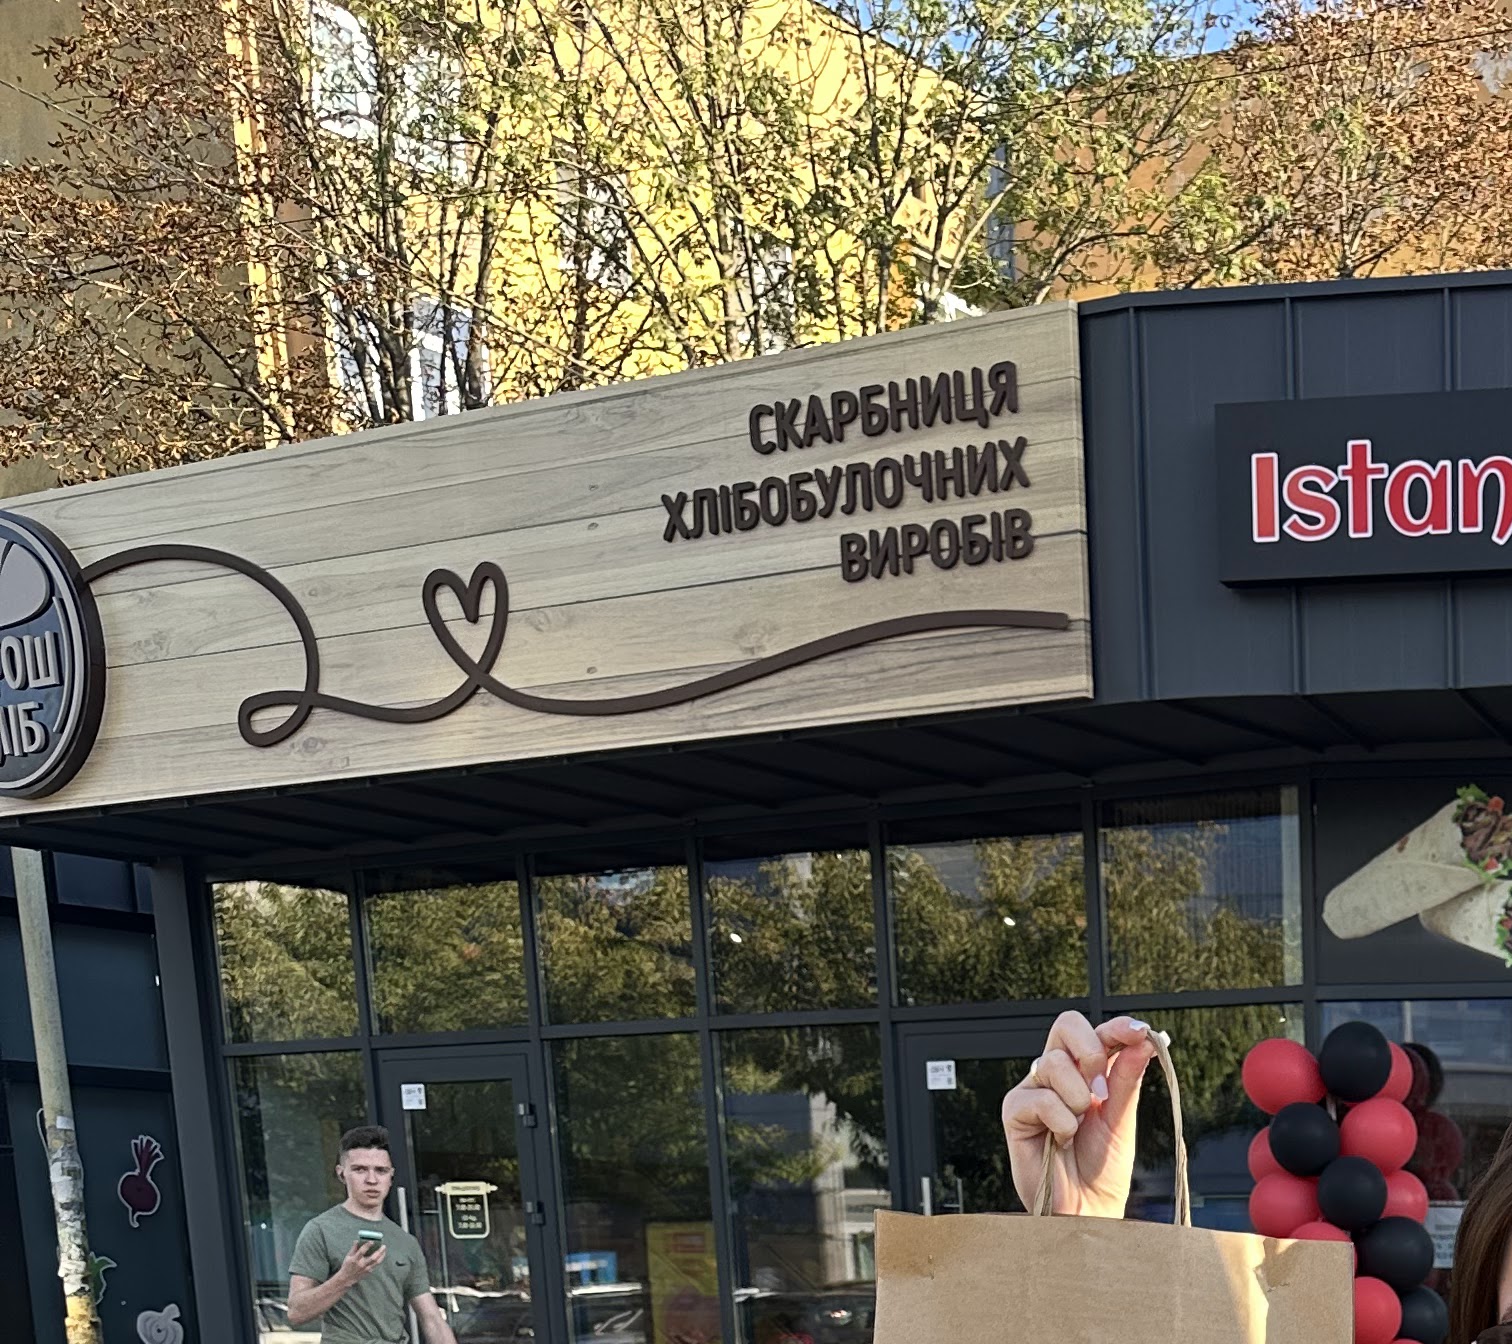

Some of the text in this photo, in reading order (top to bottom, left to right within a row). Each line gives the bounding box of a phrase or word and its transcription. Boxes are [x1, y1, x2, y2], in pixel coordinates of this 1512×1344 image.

[748, 360, 1019, 455] СКАРБНИЦЯ
[661, 436, 1031, 542] ХЛІБОБУЛОЧНИХ
[840, 508, 1034, 583] ВИРОБІВ
[0, 630, 61, 690] ОШ
